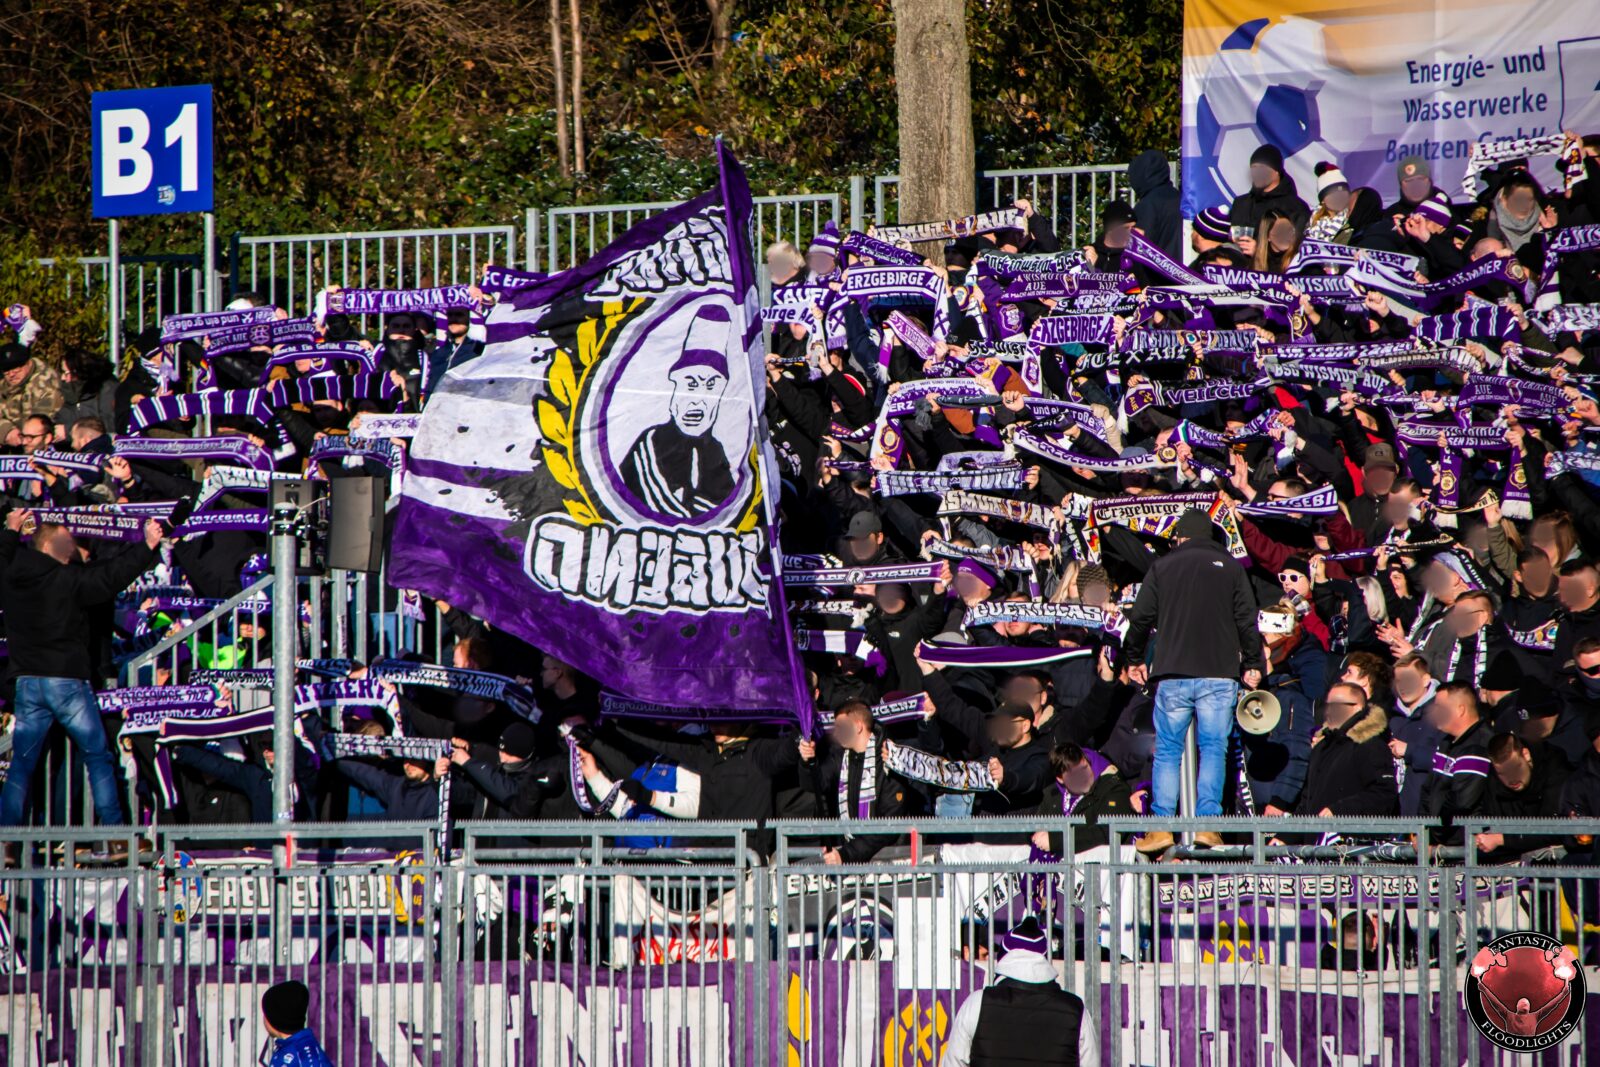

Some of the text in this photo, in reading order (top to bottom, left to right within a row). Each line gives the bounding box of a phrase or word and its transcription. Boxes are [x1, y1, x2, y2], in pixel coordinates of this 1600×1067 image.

[1406, 46, 1546, 87] Energie- und
[1403, 87, 1548, 122] Wasserwerke
[101, 103, 198, 196] B1
[1385, 138, 1469, 163] Bautzen
[847, 272, 924, 289] ERZGEBIRGE
[345, 291, 375, 309] AUE
[380, 288, 444, 308] WISMUT
[1274, 364, 1390, 393] BSG WISMUT AUE
[1096, 502, 1180, 521] Erzgebirge
[973, 600, 1102, 621] GUERILLAS
